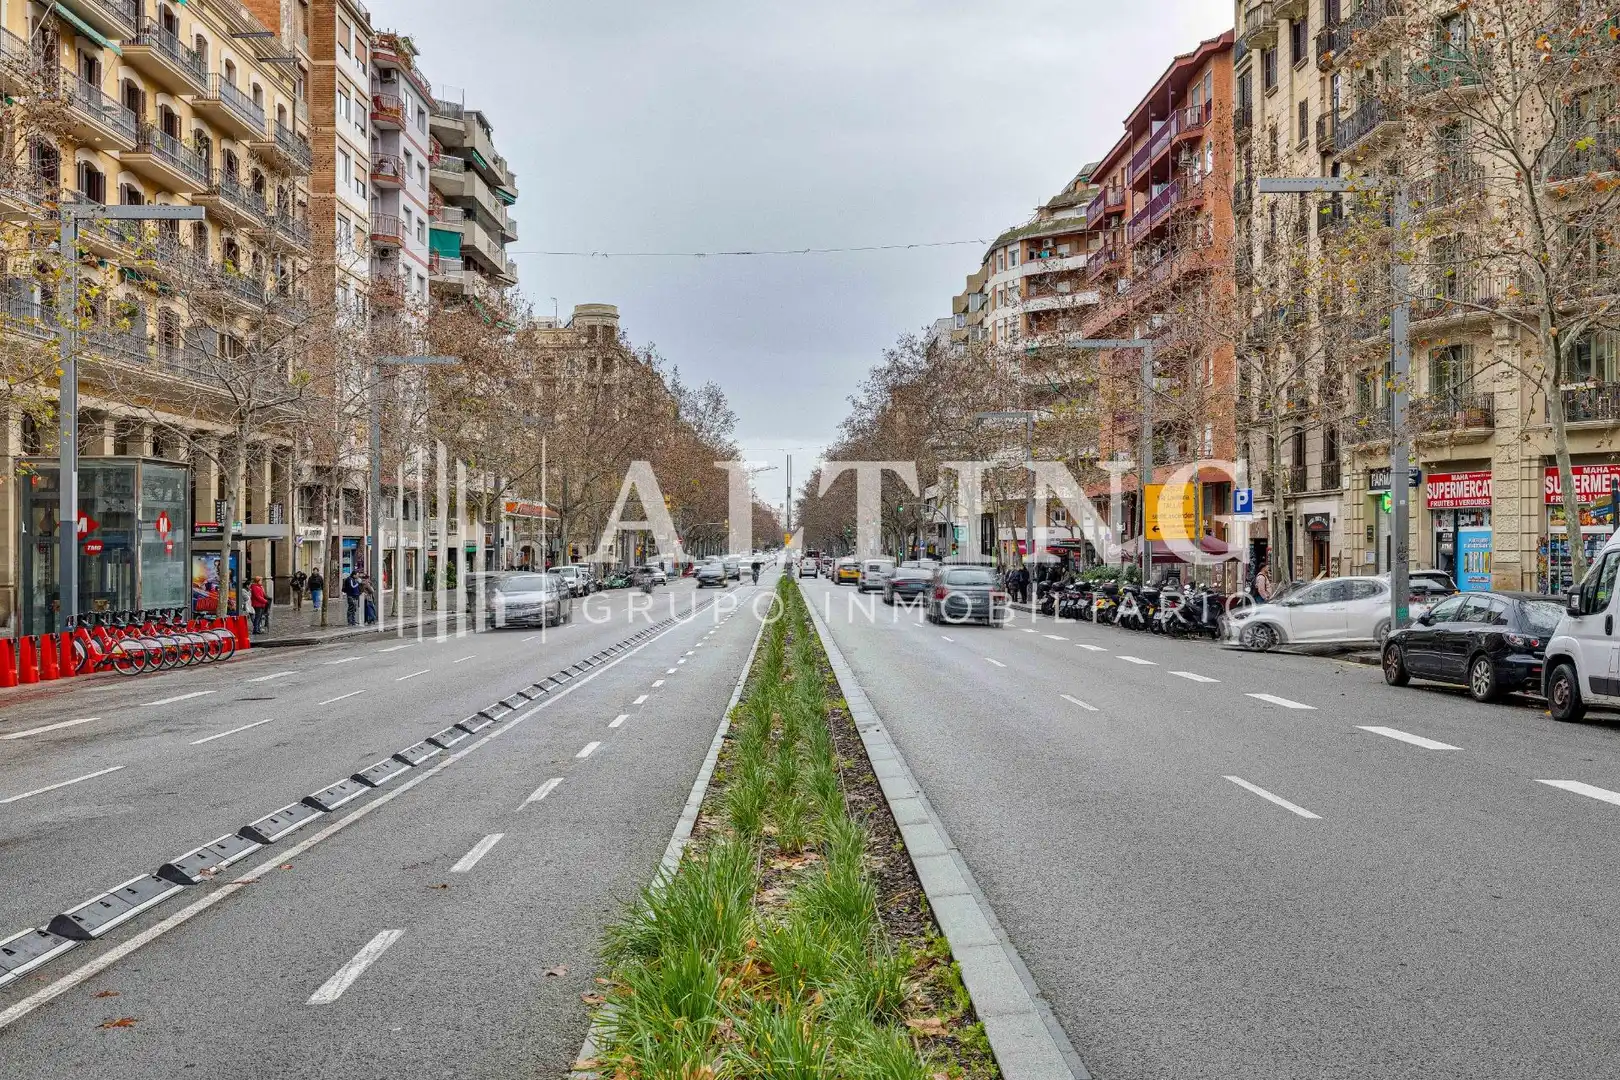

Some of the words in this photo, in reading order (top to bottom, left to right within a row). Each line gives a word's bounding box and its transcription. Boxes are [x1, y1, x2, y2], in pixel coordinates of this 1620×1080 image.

[1371, 472, 1392, 486] FARM
[1545, 474, 1620, 494] SUERME
[1427, 479, 1492, 499] SUPERMERCAT
[1459, 498, 1490, 506] VERDURES
